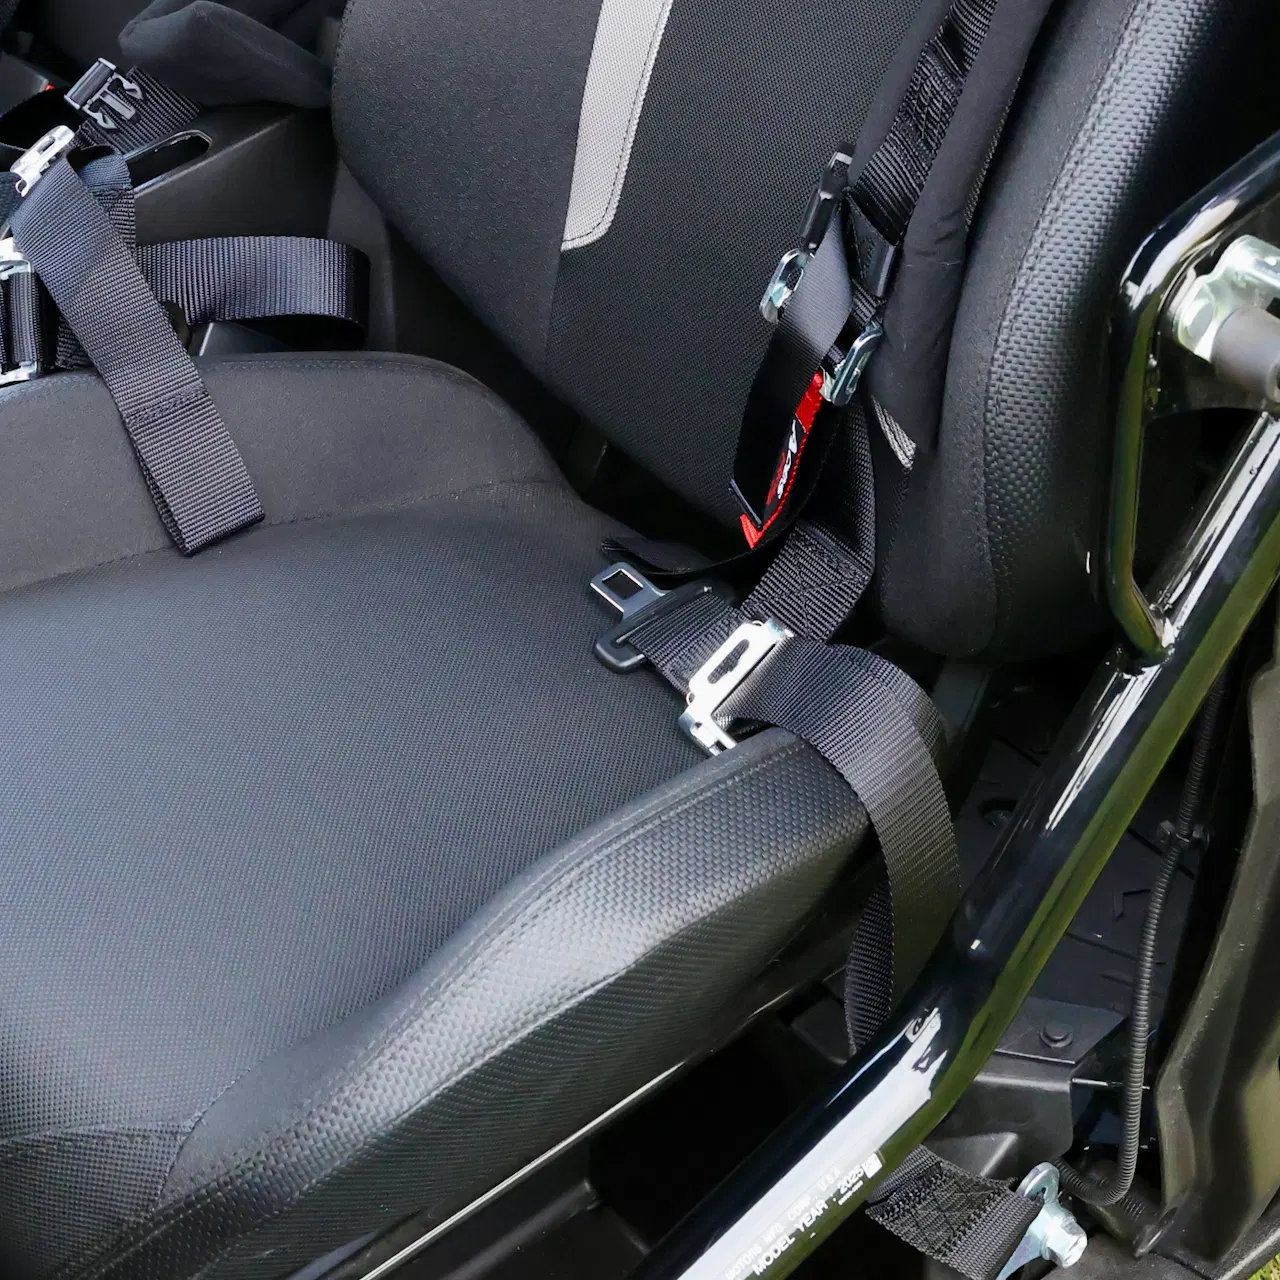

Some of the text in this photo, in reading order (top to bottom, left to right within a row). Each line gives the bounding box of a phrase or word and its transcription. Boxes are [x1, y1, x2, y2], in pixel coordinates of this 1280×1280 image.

[751, 1234, 795, 1276] MODEL
[794, 1199, 828, 1232] YEAR
[837, 1165, 864, 1194] 2025
